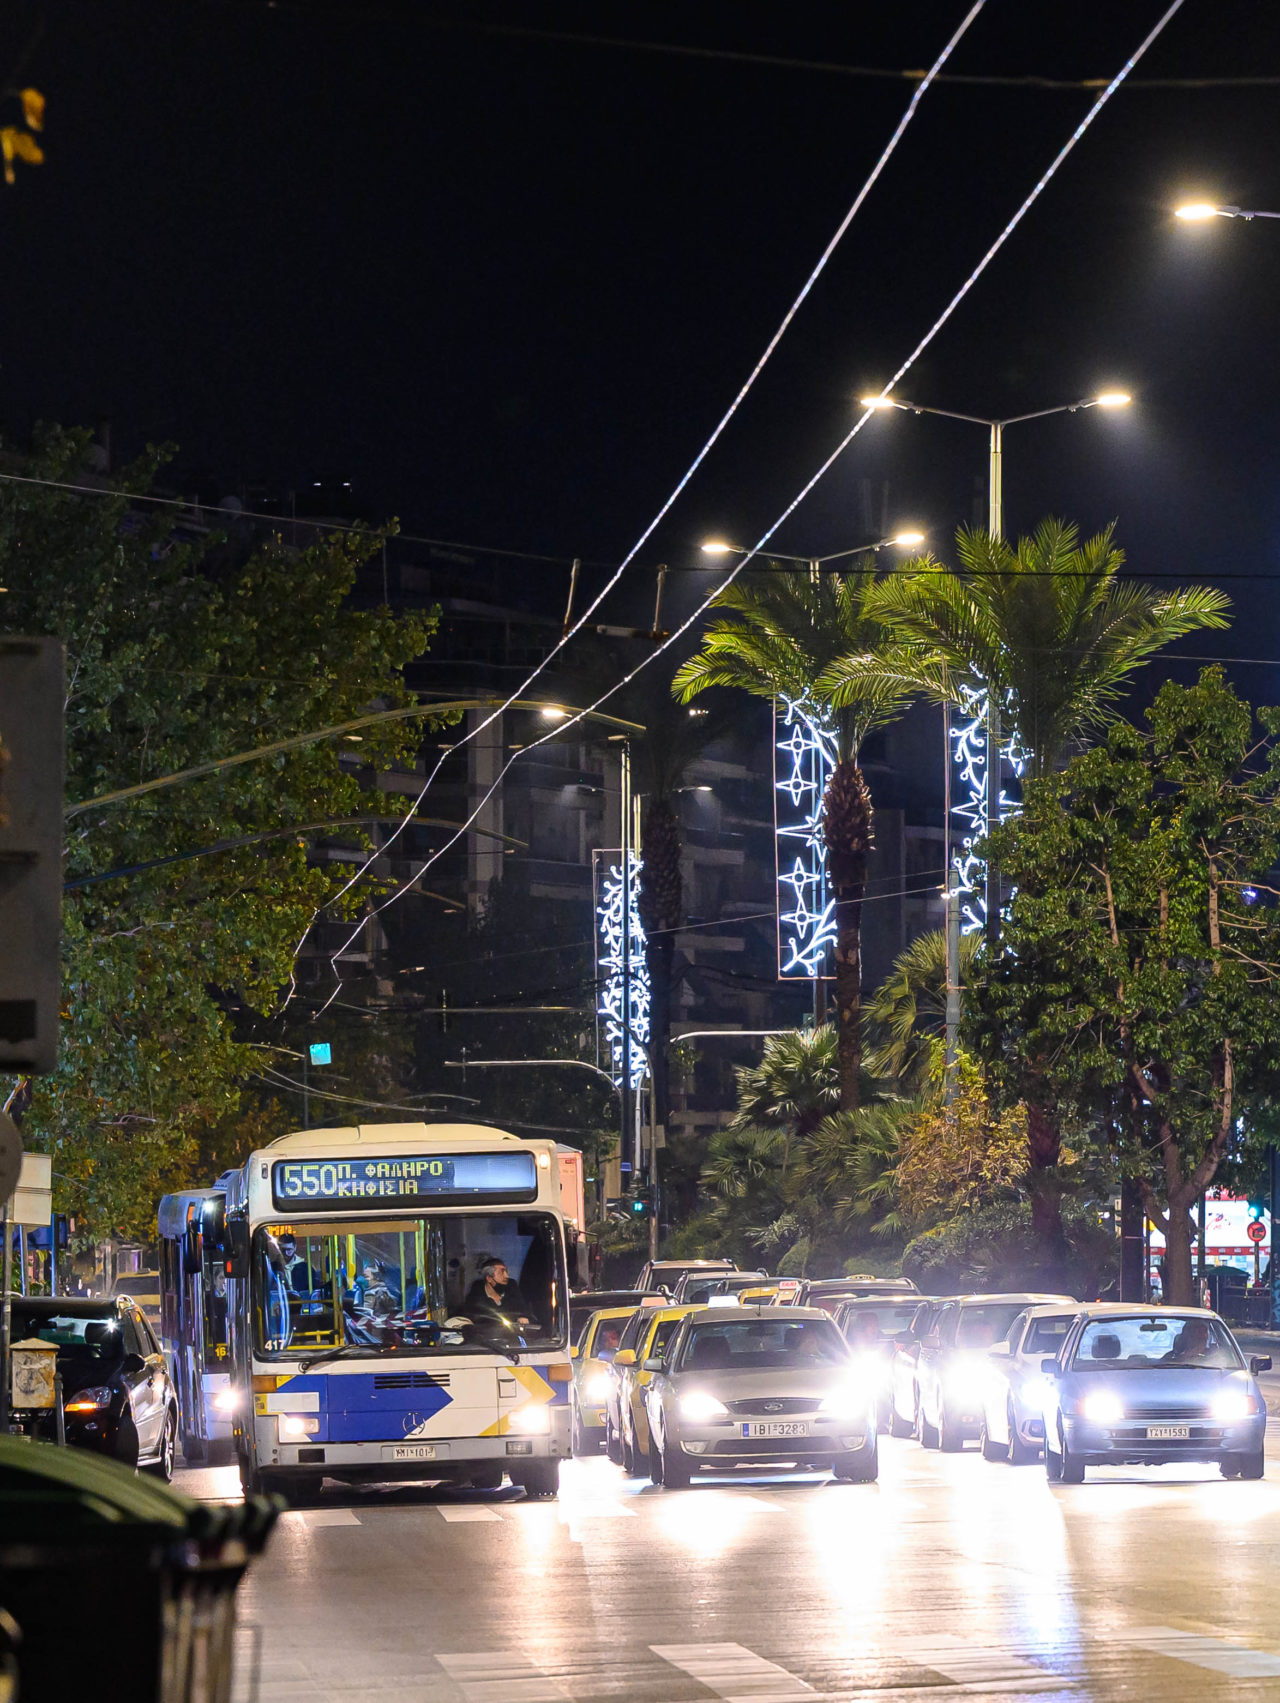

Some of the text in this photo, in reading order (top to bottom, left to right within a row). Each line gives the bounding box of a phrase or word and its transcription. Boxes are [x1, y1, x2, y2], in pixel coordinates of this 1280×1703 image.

[284, 1164, 337, 1196] 550
[338, 1180, 418, 1197] ΚΗΦΙΣΙΑ
[265, 1340, 285, 1351] 417
